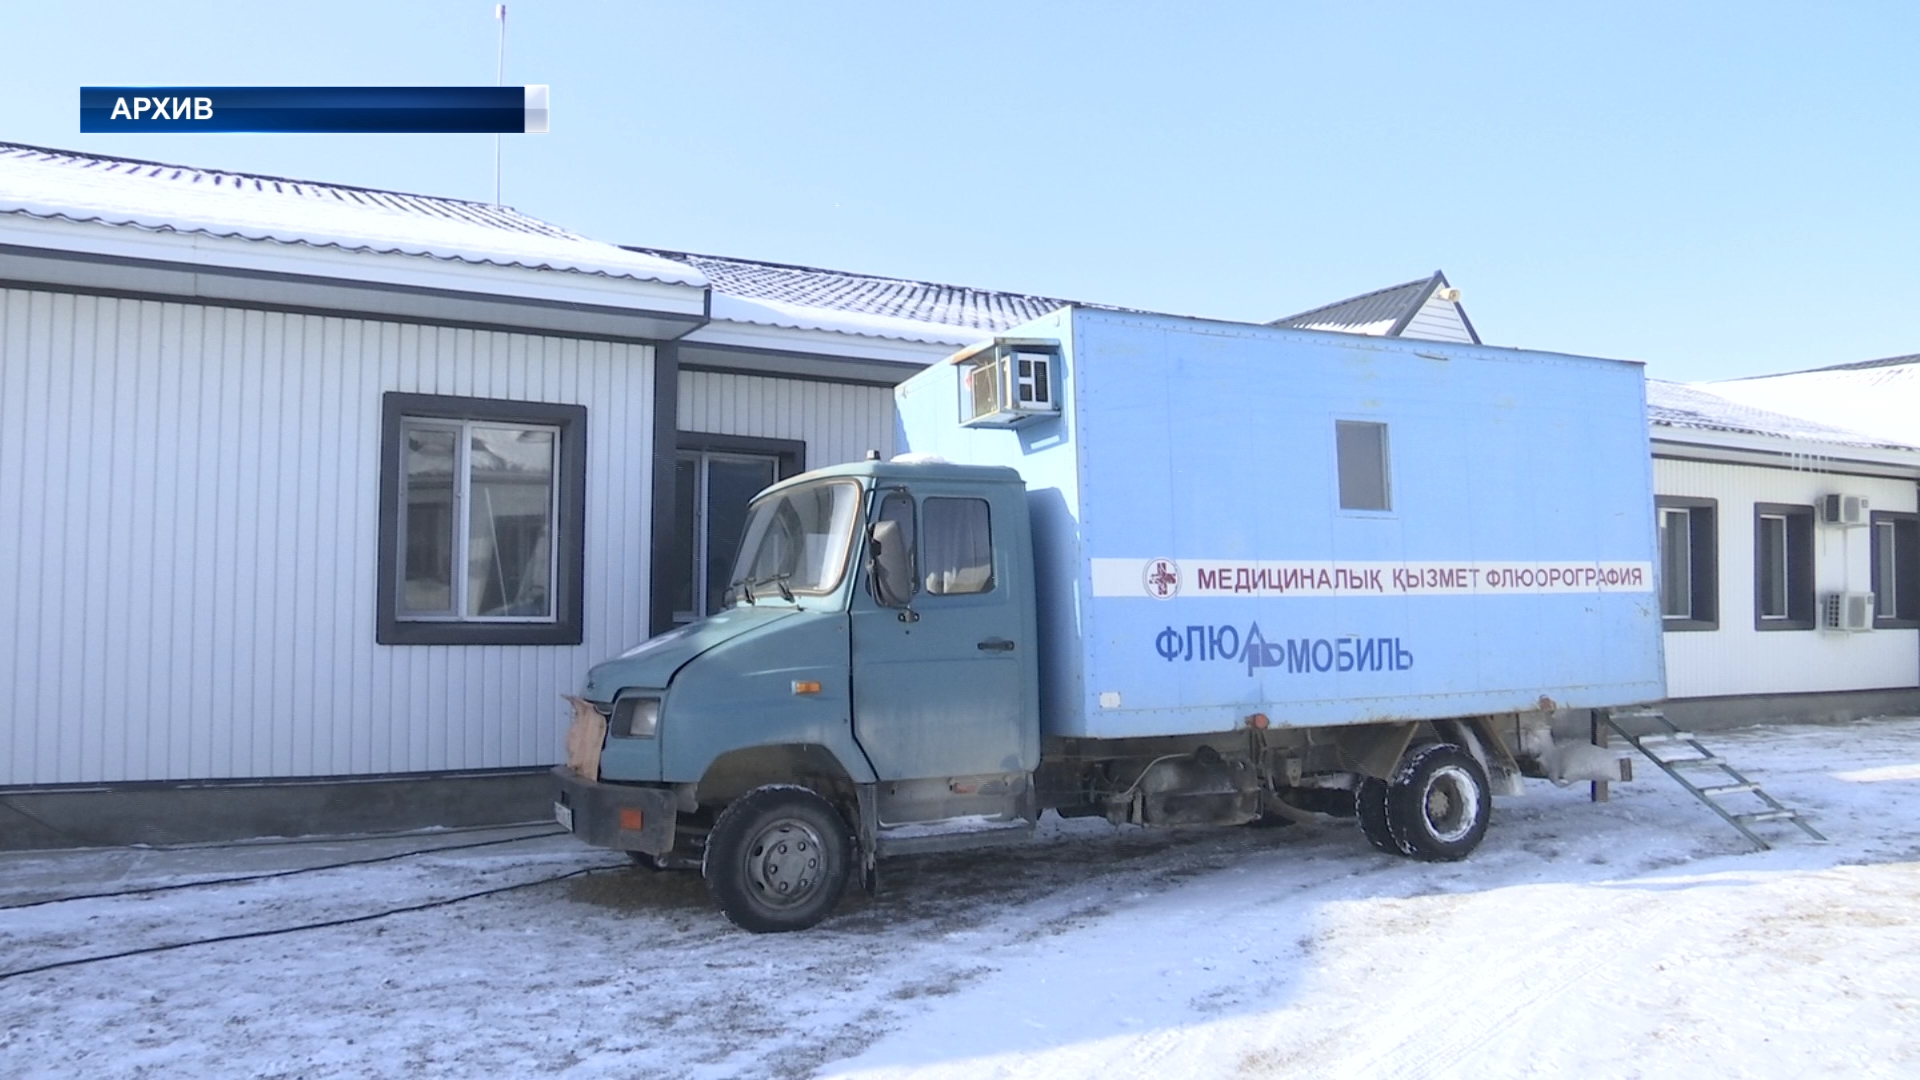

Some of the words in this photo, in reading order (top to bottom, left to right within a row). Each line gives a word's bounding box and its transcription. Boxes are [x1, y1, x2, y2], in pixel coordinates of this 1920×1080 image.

[1197, 567, 1384, 593] МЕДИЦИНАЛЫҚ
[1392, 568, 1481, 592] ҚЫЗМЕТ
[1486, 567, 1642, 588] ФЛЮОРОГРАФИЯ
